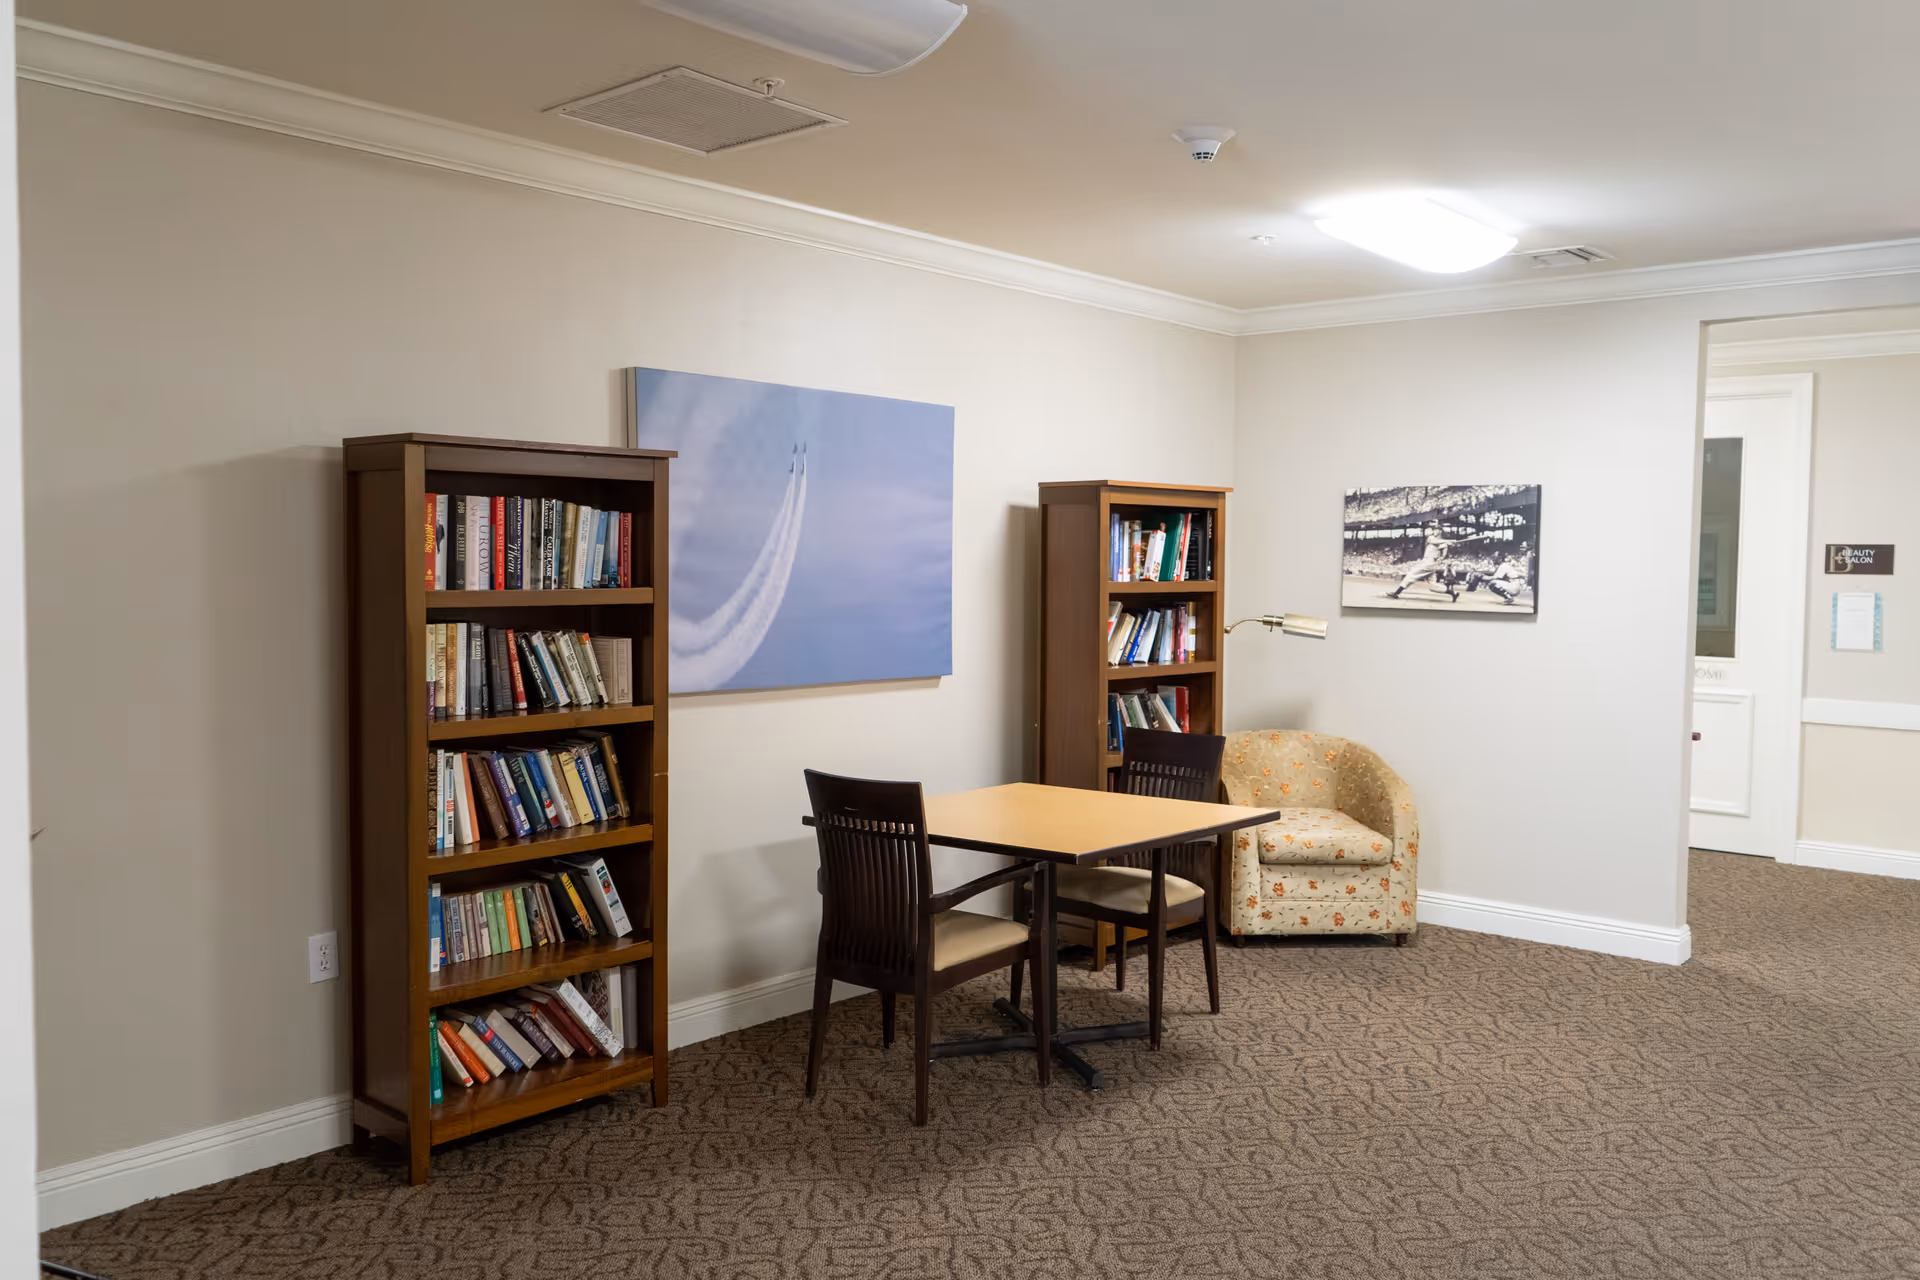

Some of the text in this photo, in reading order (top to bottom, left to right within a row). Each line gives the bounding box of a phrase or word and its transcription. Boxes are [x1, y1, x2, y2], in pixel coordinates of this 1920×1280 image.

[479, 514, 489, 575] TUROW
[1842, 549, 1876, 557] BEAUTY
[508, 543, 518, 573] Them
[1845, 556, 1873, 564] SALON
[577, 759, 588, 782] LAURA
